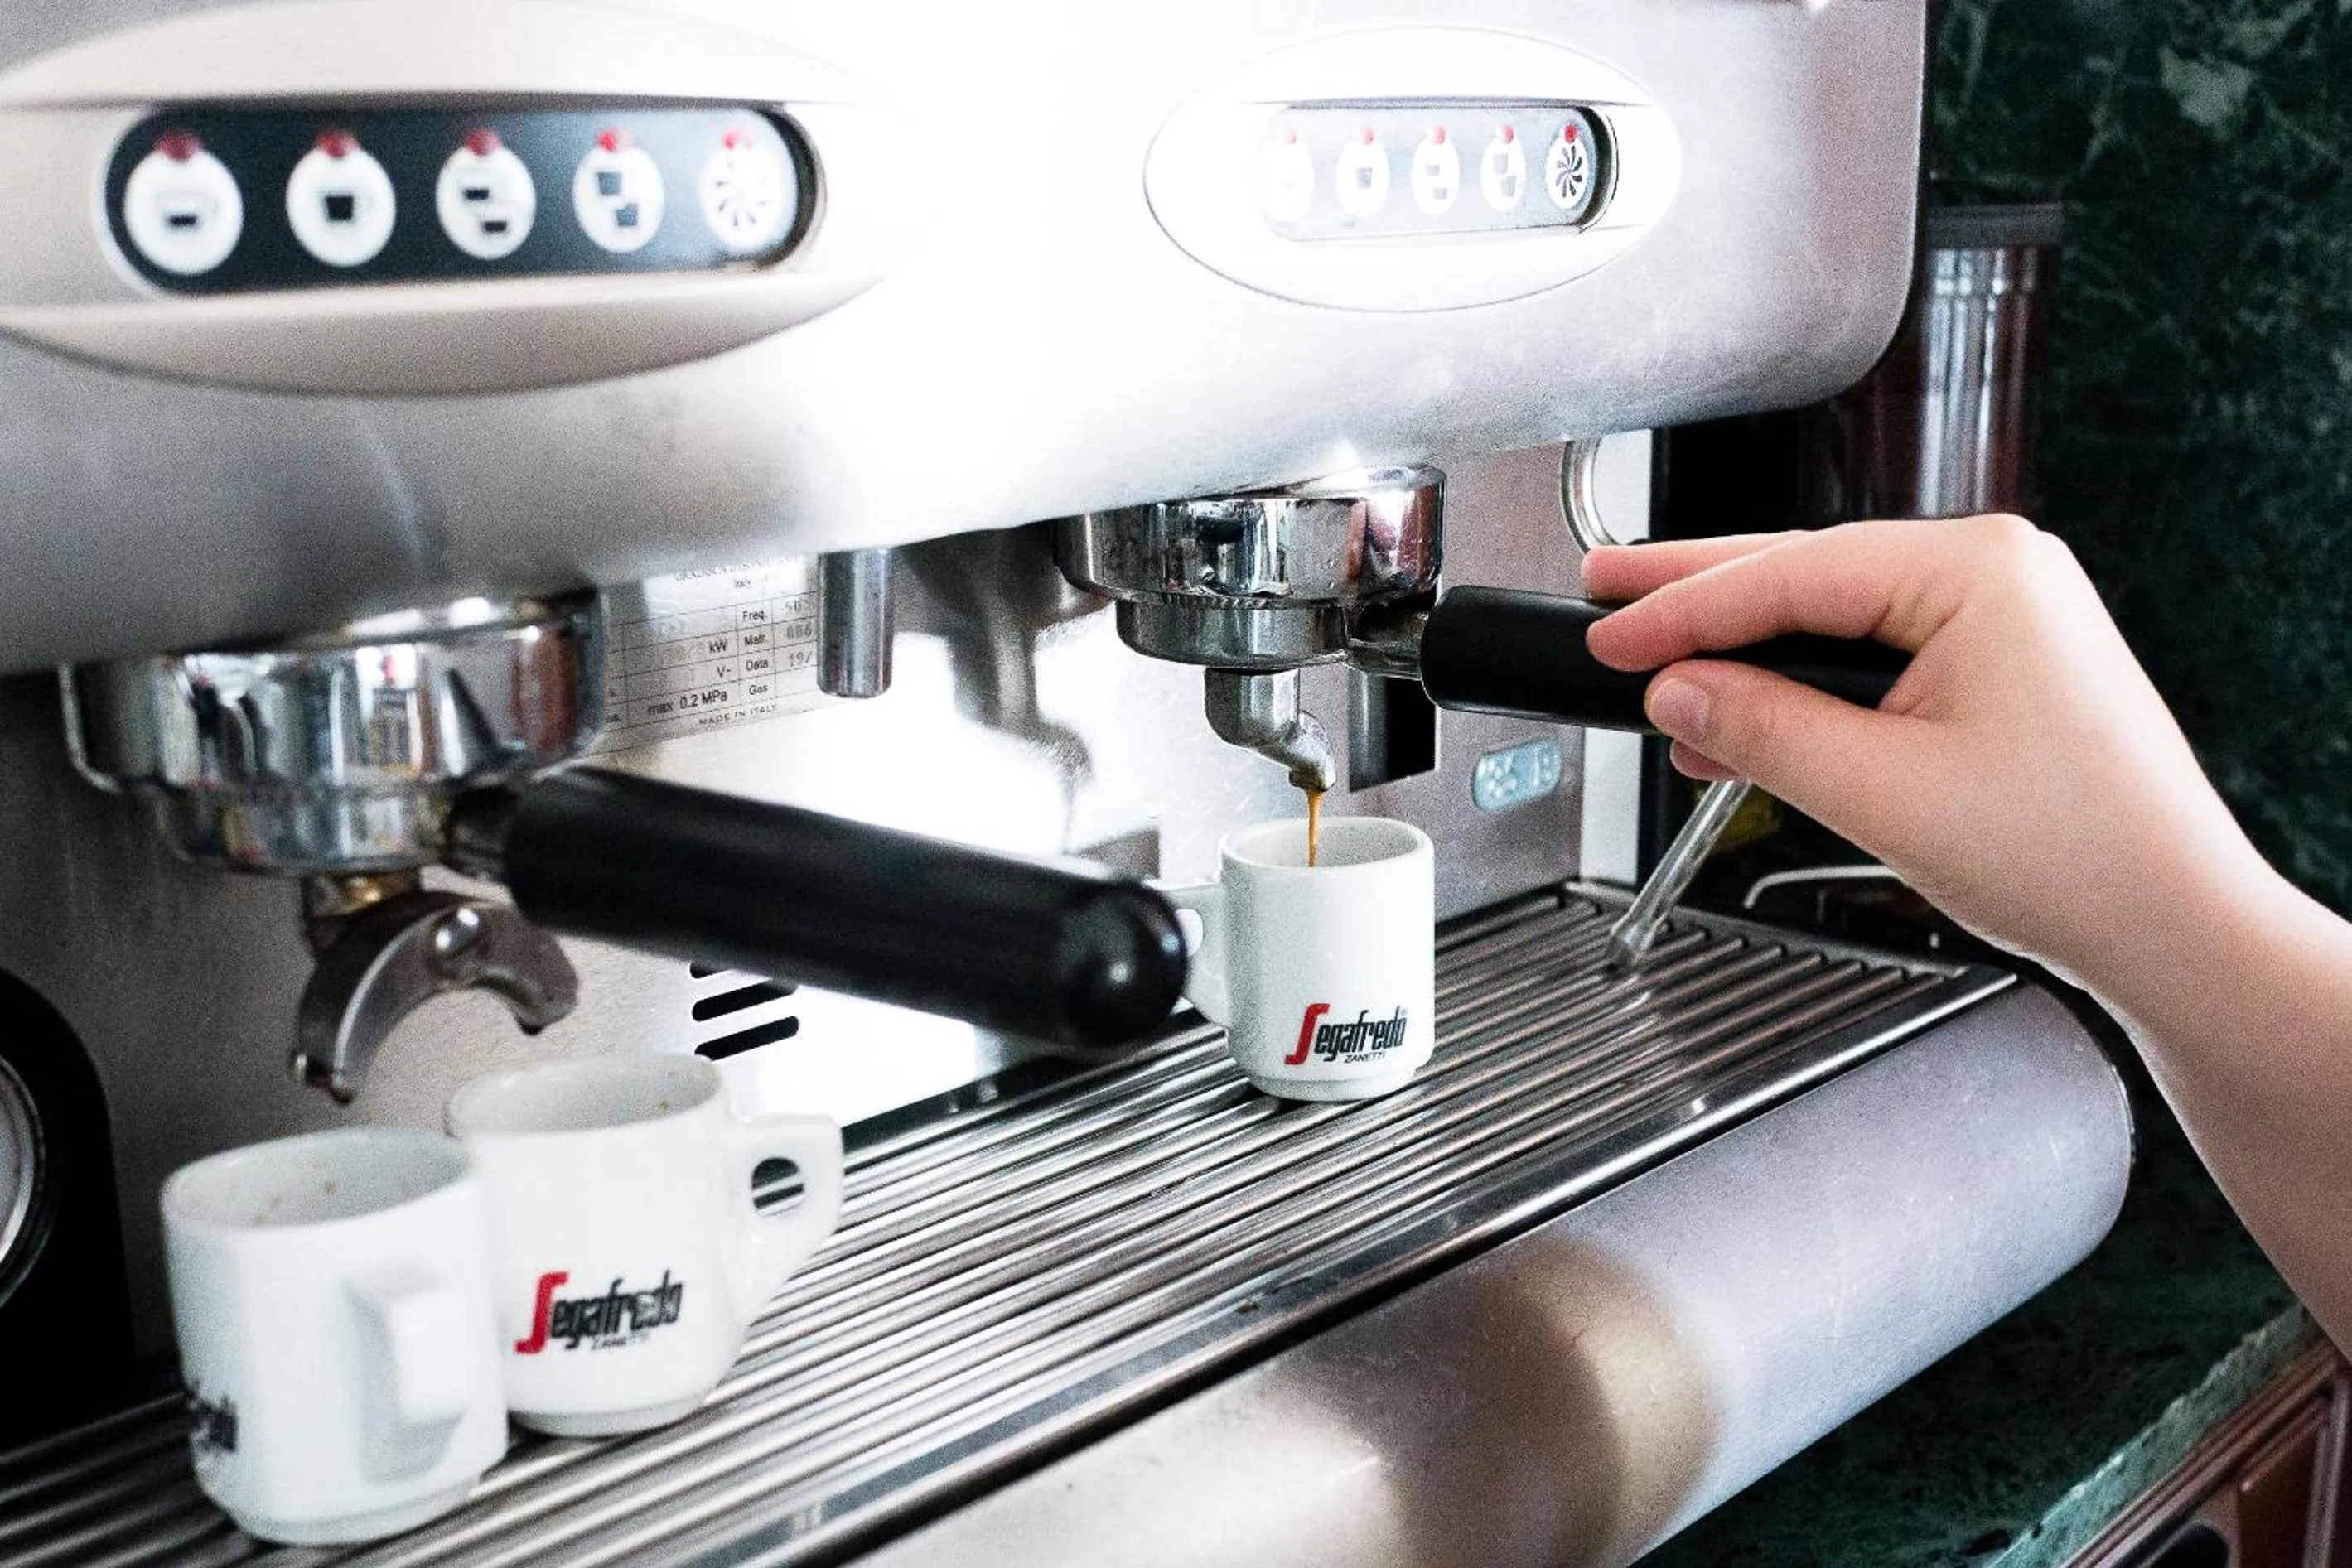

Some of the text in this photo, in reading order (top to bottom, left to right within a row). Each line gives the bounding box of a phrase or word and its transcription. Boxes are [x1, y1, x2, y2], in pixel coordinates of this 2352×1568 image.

[746, 659, 770, 672] Data
[748, 684, 769, 695] Gas
[701, 689, 727, 705] MPa
[1284, 1002, 1408, 1065] Segafredo
[1344, 1052, 1386, 1064] ZANETTI
[514, 1269, 683, 1354] Segafredo
